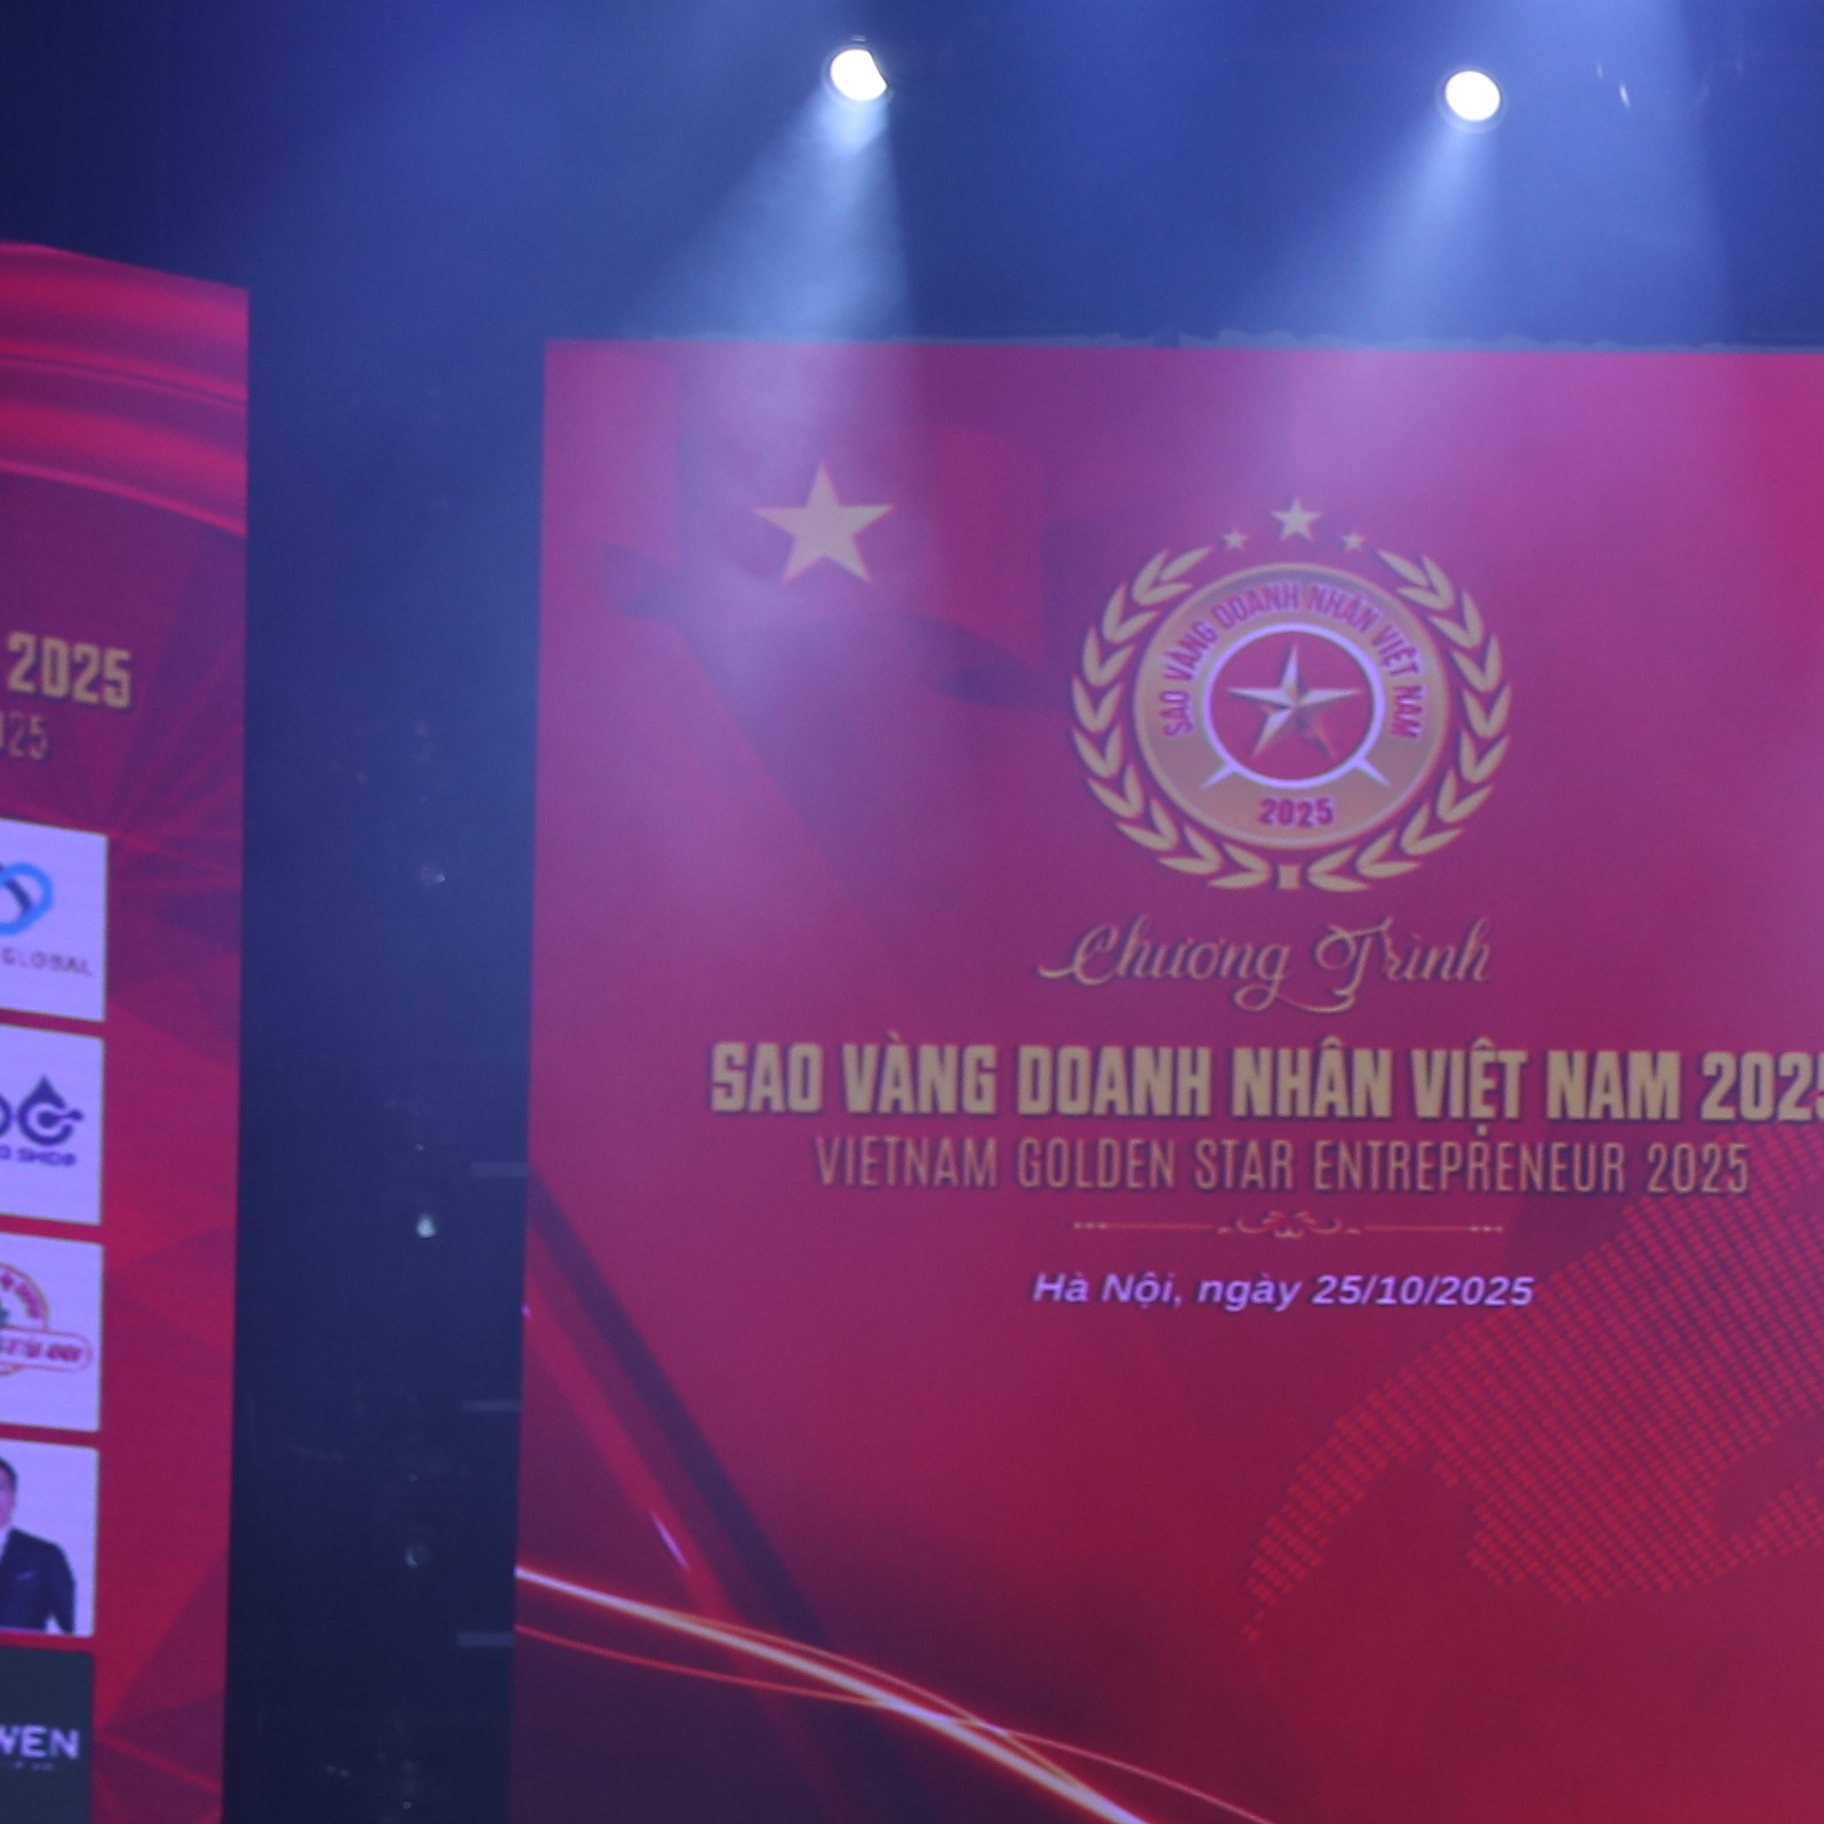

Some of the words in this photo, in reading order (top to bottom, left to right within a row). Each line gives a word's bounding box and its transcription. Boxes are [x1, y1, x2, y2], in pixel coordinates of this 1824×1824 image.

[8, 630, 132, 709] 2025
[0, 711, 48, 760] 25
[1258, 797, 1336, 827] 2025
[1037, 914, 1292, 1012] Chương
[1315, 915, 1490, 1010] Trình
[711, 1041, 824, 1113] SAO
[842, 1032, 997, 1115] VÀNG
[1017, 1046, 1211, 1117] DOANH
[1232, 1035, 1393, 1118] NHÂN
[1412, 1037, 1528, 1136] VIỆT
[1546, 1050, 1681, 1120] NAM
[814, 1136, 997, 1187] VIETNAM
[1017, 1138, 1175, 1189] GOLDEN
[1196, 1139, 1293, 1190] STAR
[1314, 1141, 1625, 1192] ENTREPRENEUR
[1647, 1143, 1748, 1193] 2025
[1032, 1273, 1089, 1303] Hà
[1102, 1273, 1182, 1311] Nội,
[1197, 1273, 1301, 1312] ngày
[1312, 1274, 1535, 1306] 25/10/2025
